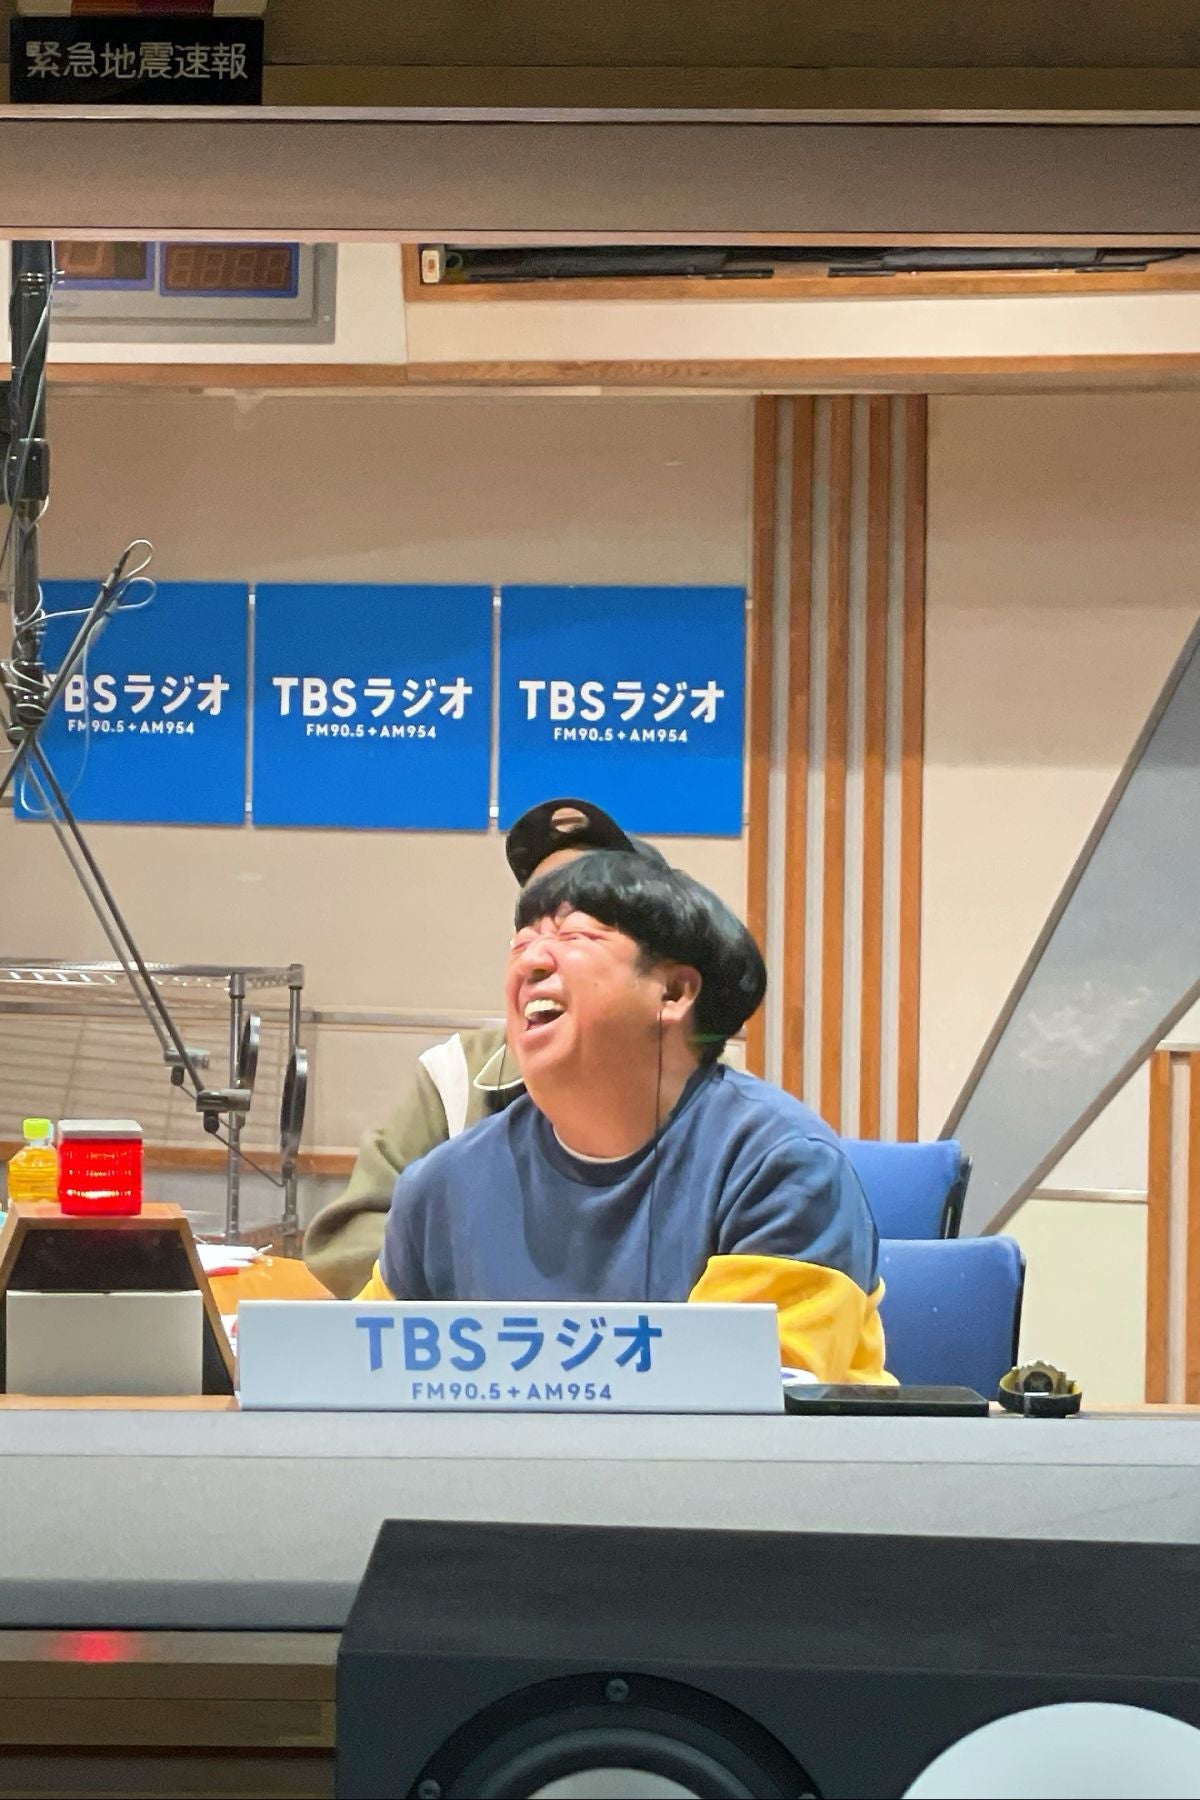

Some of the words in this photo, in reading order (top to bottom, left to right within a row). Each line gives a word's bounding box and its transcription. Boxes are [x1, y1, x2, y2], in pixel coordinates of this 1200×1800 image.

[26, 41, 248, 79] 緊急地震速報
[272, 677, 474, 720] TBSラジオ
[518, 680, 725, 723] TBSラジオ
[356, 1315, 663, 1373] TBSラジオ
